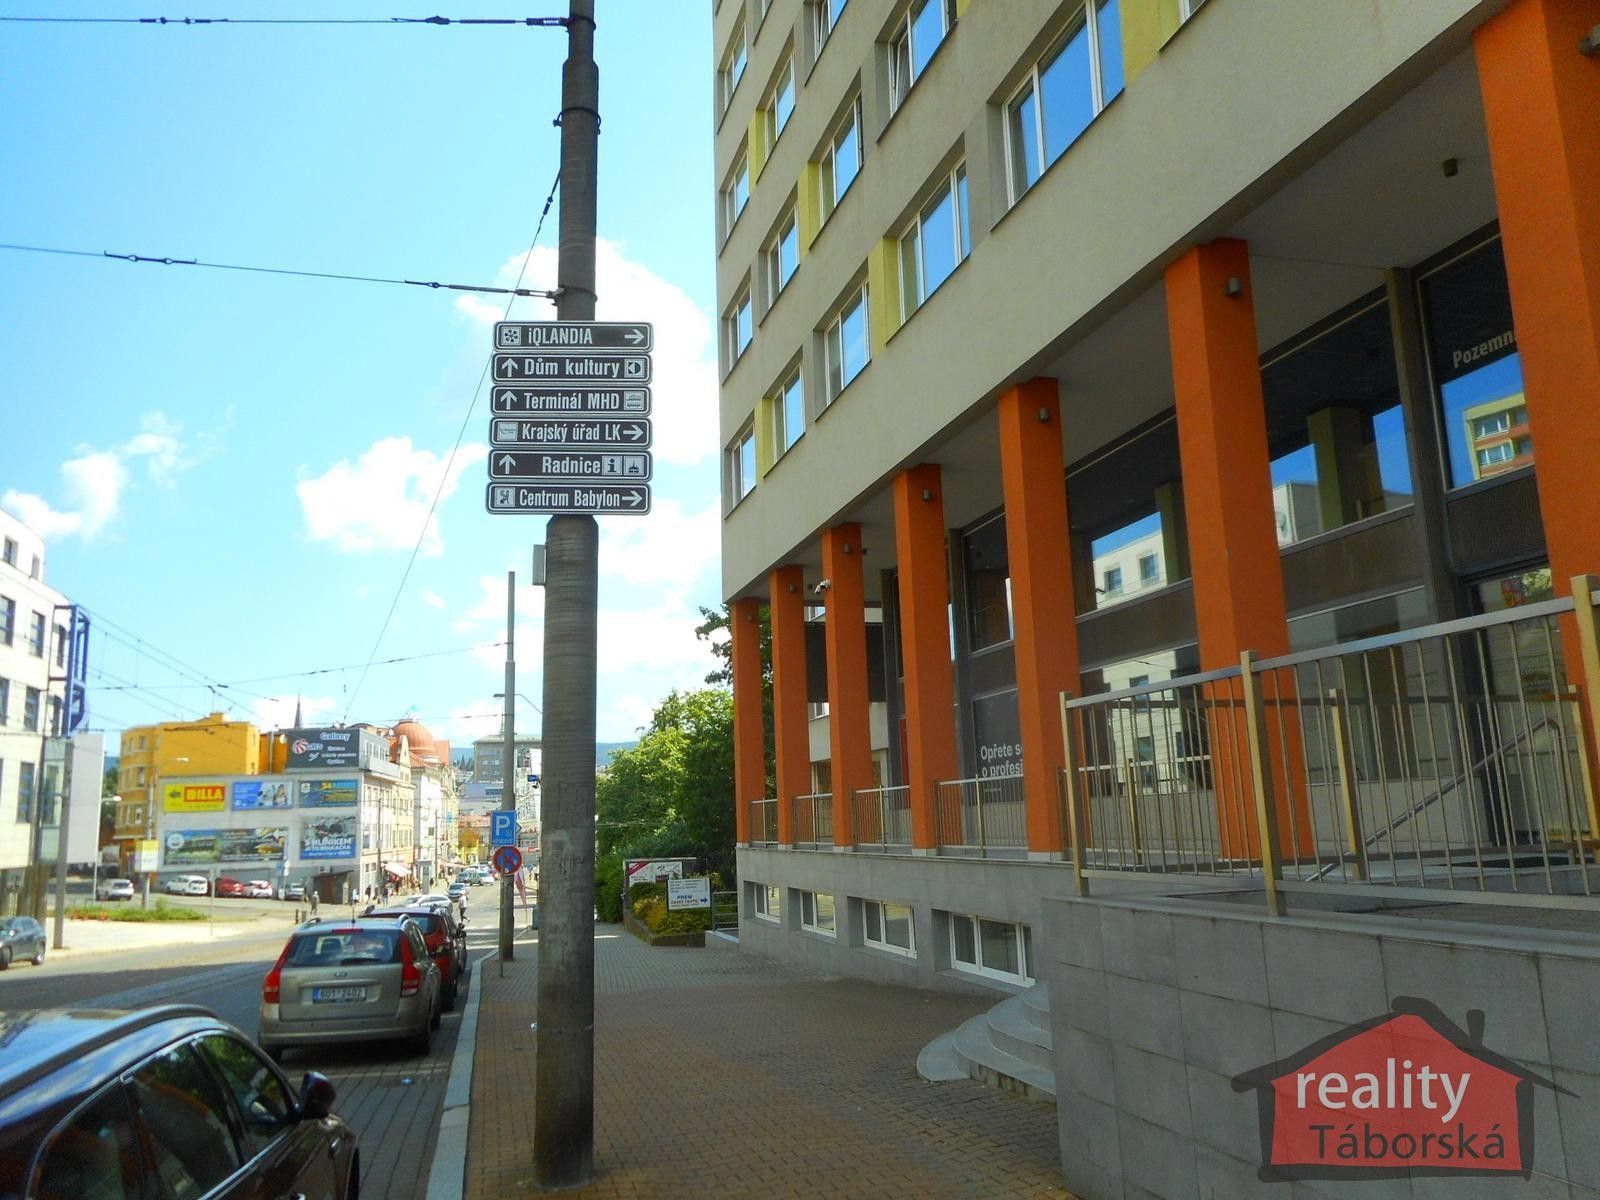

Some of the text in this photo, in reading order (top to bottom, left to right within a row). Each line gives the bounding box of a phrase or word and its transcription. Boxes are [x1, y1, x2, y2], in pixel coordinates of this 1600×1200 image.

[528, 327, 593, 346] iQLANDIA
[524, 357, 620, 378] Dům kultury
[524, 392, 620, 410] Terminál MHD
[522, 423, 621, 443] Krajský úřad LK
[542, 456, 601, 474] Radnice
[519, 488, 620, 509] Centrum Babylon
[980, 743, 1013, 763] Opřete
[982, 767, 988, 778] o
[186, 788, 223, 801] BILLA
[495, 815, 511, 836] P
